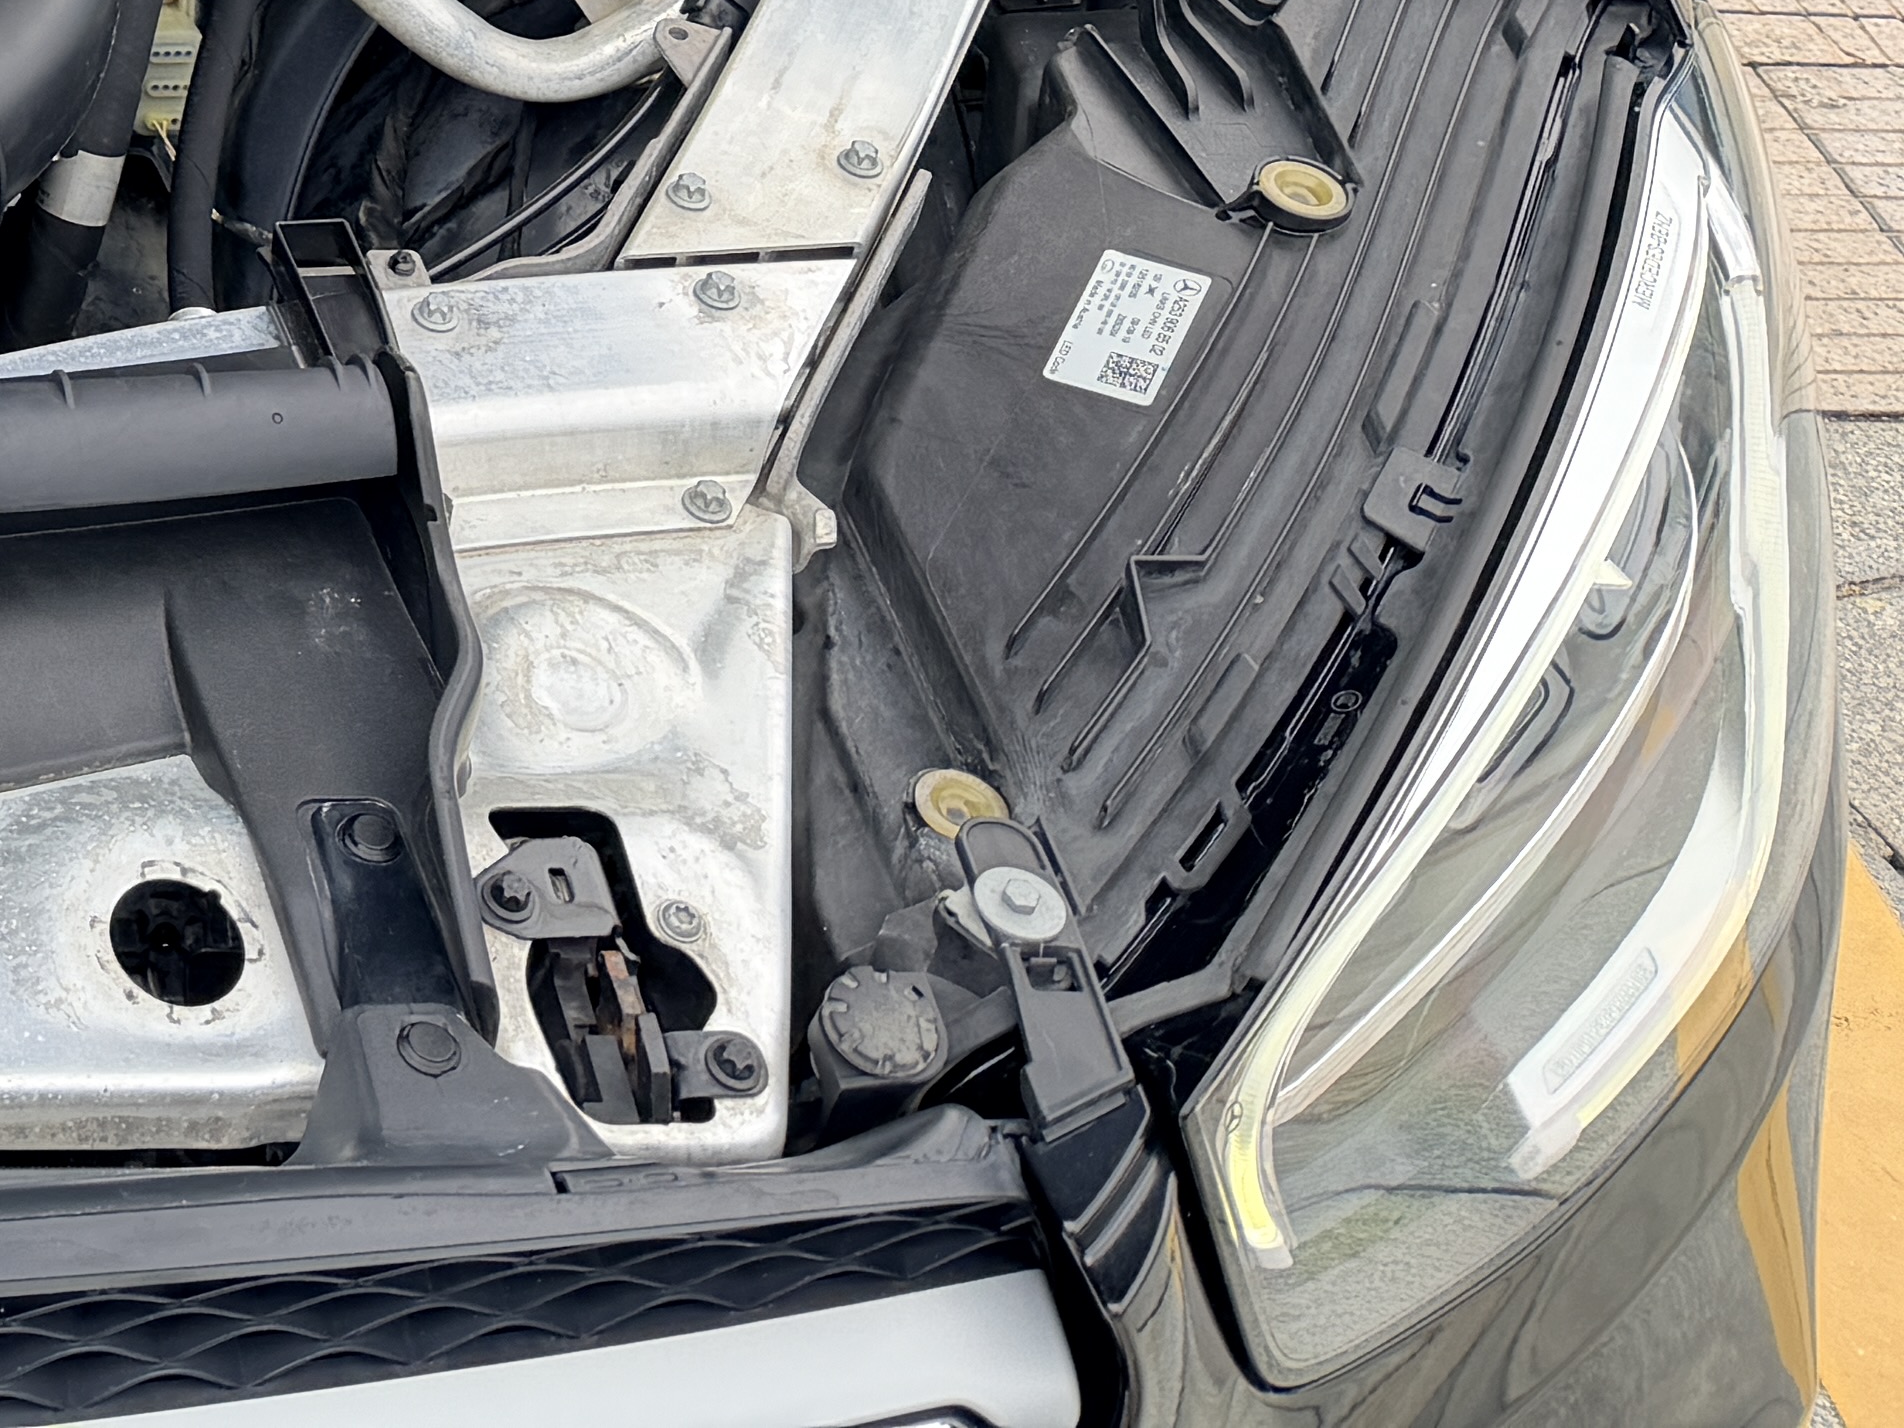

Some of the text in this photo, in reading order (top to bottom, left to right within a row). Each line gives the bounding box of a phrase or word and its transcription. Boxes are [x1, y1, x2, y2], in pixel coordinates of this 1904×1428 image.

[1632, 211, 1674, 310] MERCEDES-BENZ
[1089, 280, 1104, 298] Made
[1169, 296, 1189, 317] A253
[1072, 306, 1089, 329] Austria
[1059, 340, 1073, 356] LED
[1050, 357, 1065, 374] Code
